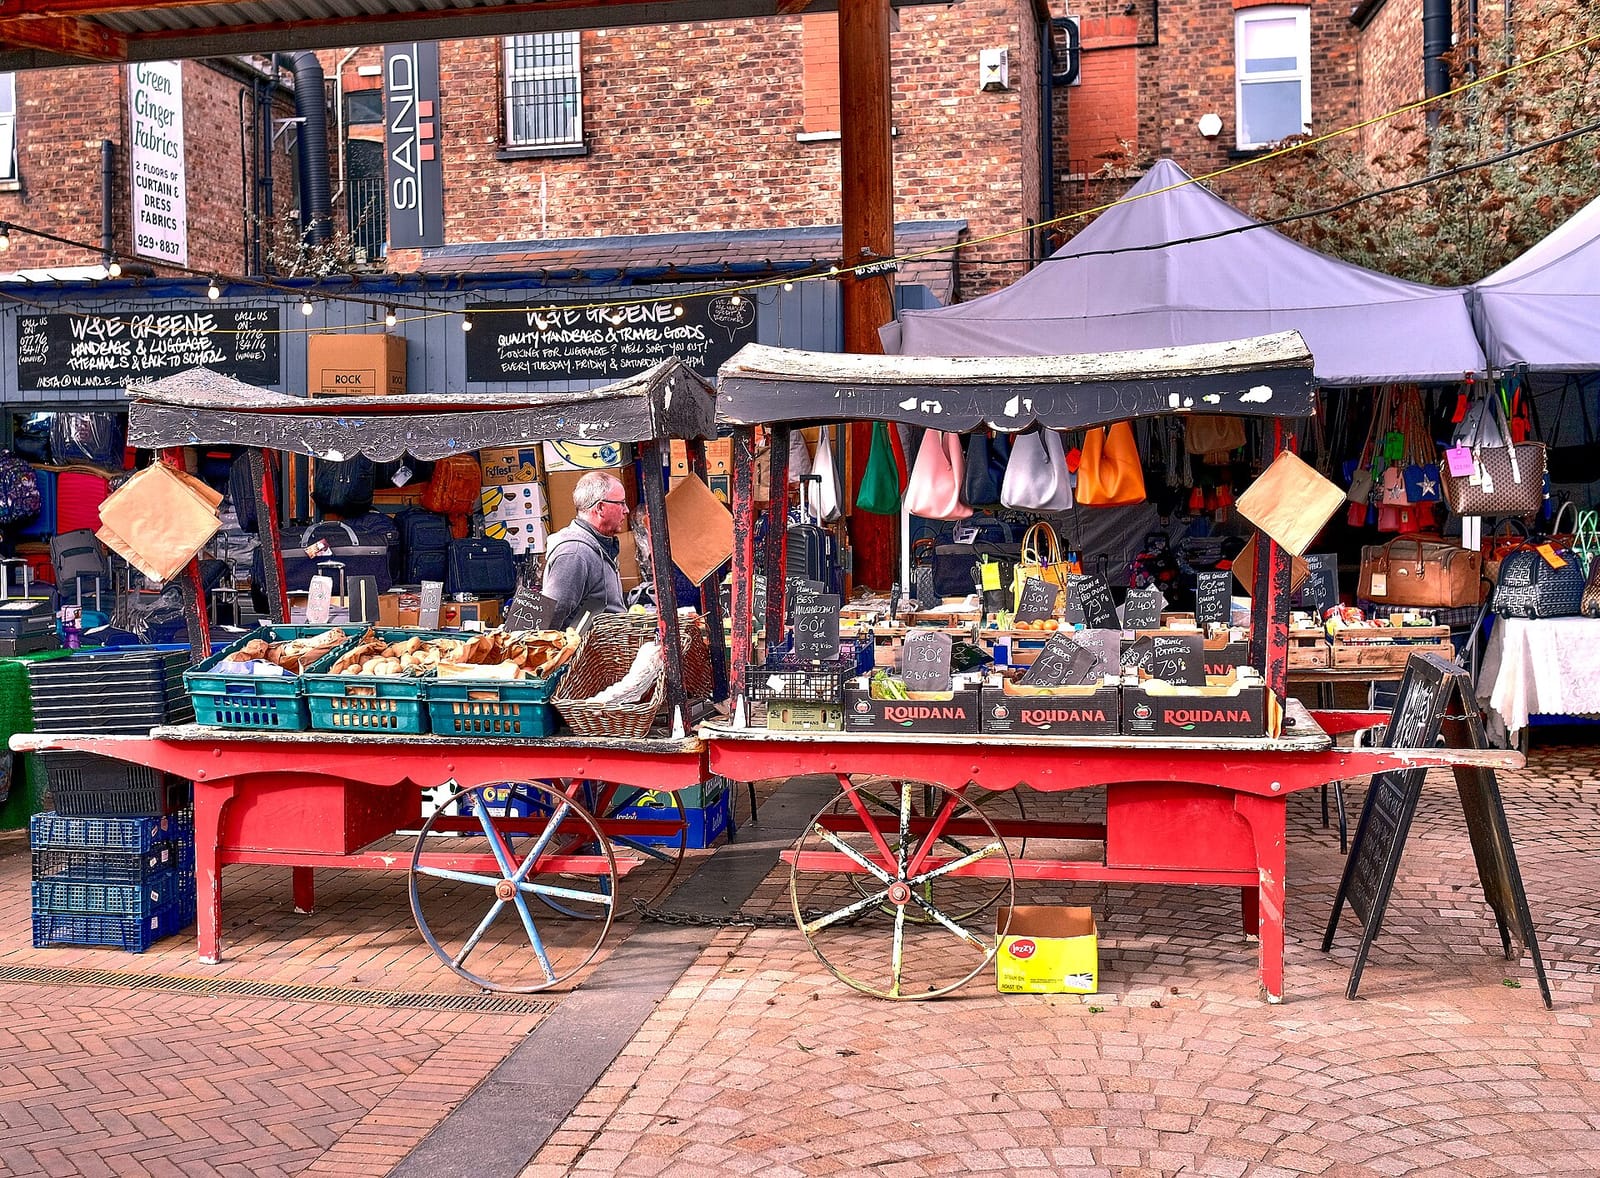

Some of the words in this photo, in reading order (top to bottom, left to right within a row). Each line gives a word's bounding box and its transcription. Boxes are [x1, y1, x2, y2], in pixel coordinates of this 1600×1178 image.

[136, 62, 172, 95] Green
[135, 89, 175, 128] Ginger
[135, 119, 178, 159] Fabrics
[389, 54, 416, 209] SAND
[136, 161, 141, 170] 2
[143, 163, 168, 179] FLOORS
[170, 171, 178, 182] OF
[136, 176, 172, 196] CURTAIN
[144, 194, 171, 212] DRESS
[141, 210, 177, 230] FABRICS
[235, 312, 257, 321] CALL
[257, 311, 268, 321] US
[586, 302, 676, 323] GREENE
[22, 319, 38, 327] CALL
[39, 317, 48, 326] US
[70, 314, 124, 340] W&E
[130, 312, 218, 340] GREENE
[20, 332, 48, 345] 07776
[498, 331, 539, 348] QUALITY
[541, 329, 604, 344] HANDBAGS
[605, 327, 618, 343] &
[617, 327, 662, 341] TRAVEL
[664, 325, 705, 339] GOODS
[71, 340, 131, 357] HANDBAGS
[135, 340, 147, 355] &
[542, 347, 561, 357] FOR
[646, 343, 668, 353] SORT
[668, 342, 684, 355] YOU
[67, 356, 129, 371] THERMALS
[131, 355, 140, 372] &
[142, 355, 167, 369] BACK
[167, 356, 180, 367] TO
[182, 348, 227, 366] SCHOOL
[501, 360, 530, 374] EVERY
[576, 358, 607, 375] FRIDAY
[610, 359, 619, 371] &
[335, 374, 361, 384] ROCK
[796, 595, 818, 604] BEST
[1155, 646, 1190, 658] POTATOES
[884, 707, 966, 721] ROUDANA
[1021, 709, 1106, 724] ROUDANA
[1164, 709, 1251, 724] ROUDANA
[1012, 943, 1034, 954] jazzy
